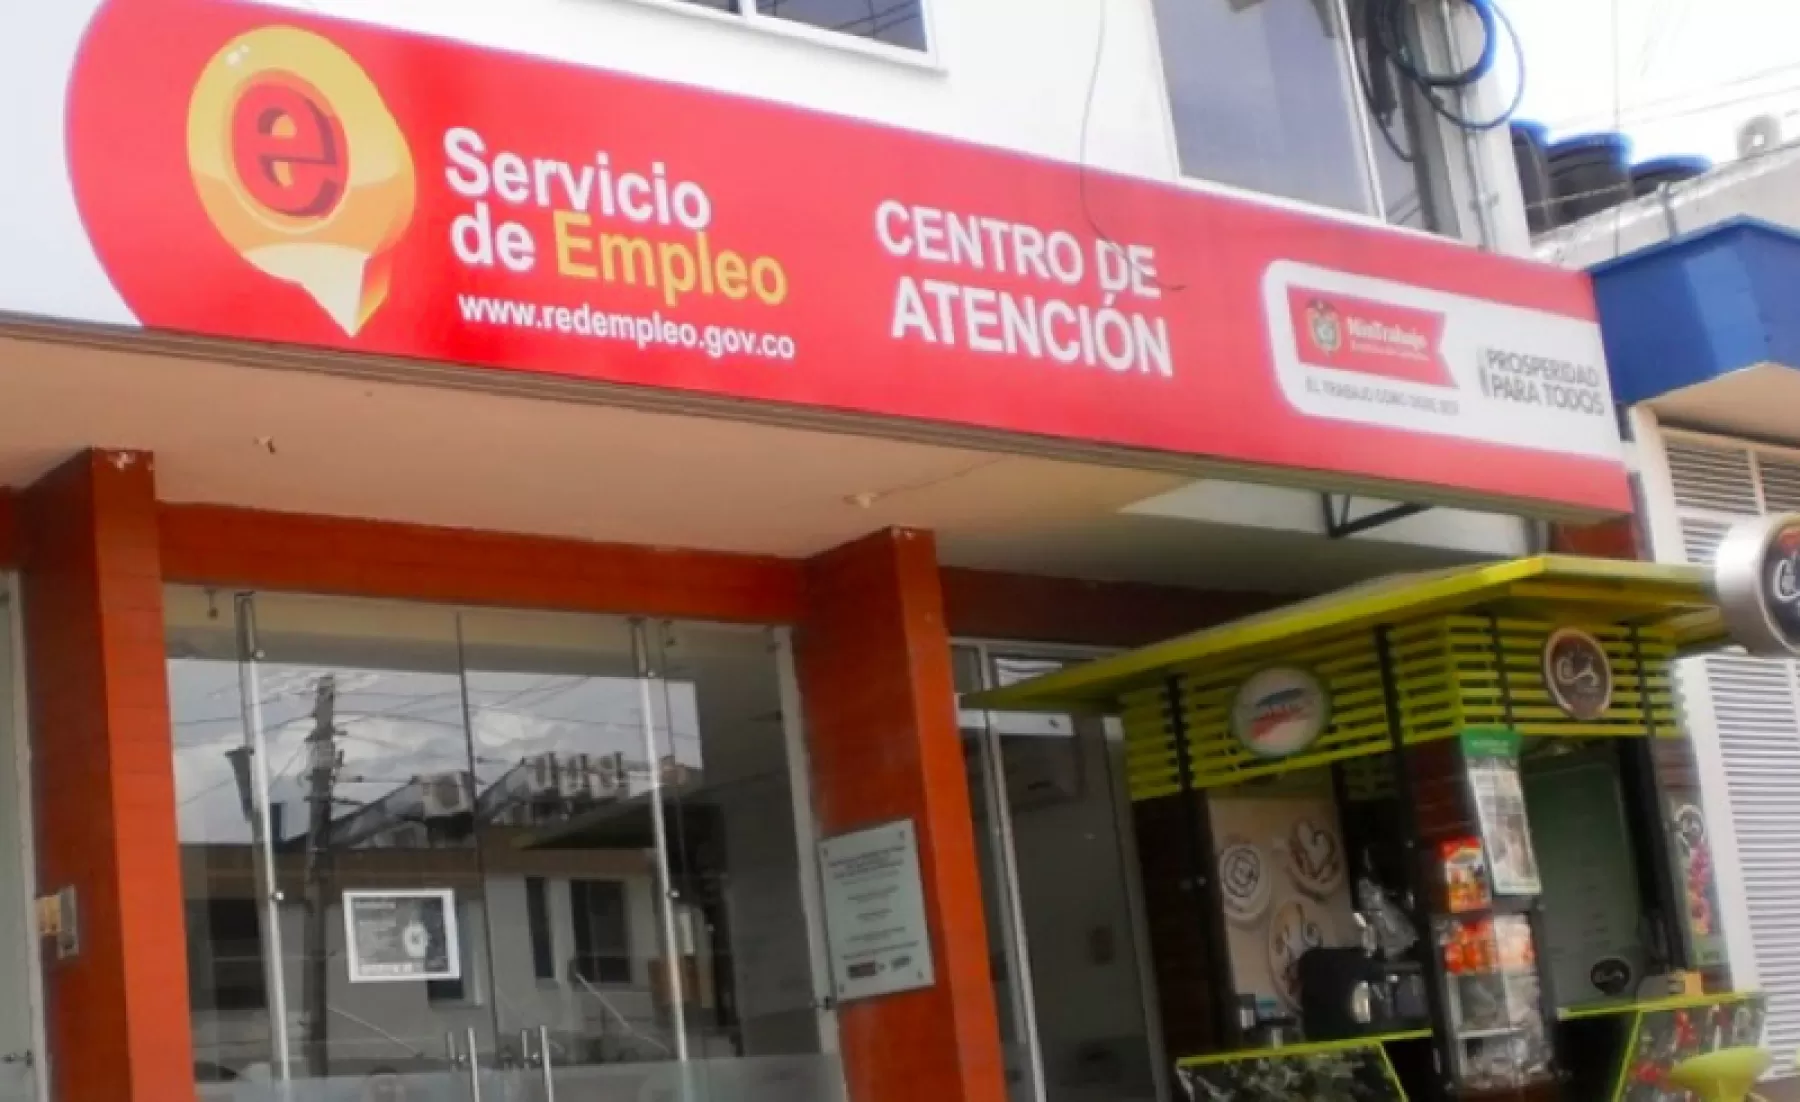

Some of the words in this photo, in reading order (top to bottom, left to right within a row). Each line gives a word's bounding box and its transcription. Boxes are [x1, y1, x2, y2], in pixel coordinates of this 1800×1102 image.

[443, 127, 711, 229] Servicio
[450, 201, 536, 271] de
[553, 210, 788, 306] Empleo
[875, 200, 1084, 284] CENTRO
[1095, 238, 1161, 299] DE
[458, 294, 796, 357] www.redempleo.gov.co
[891, 277, 1173, 377] ATENCIÓN
[1487, 348, 1601, 388] PROSPERIDAD
[1491, 373, 1541, 406] PARA
[1540, 382, 1605, 416] TODOS
